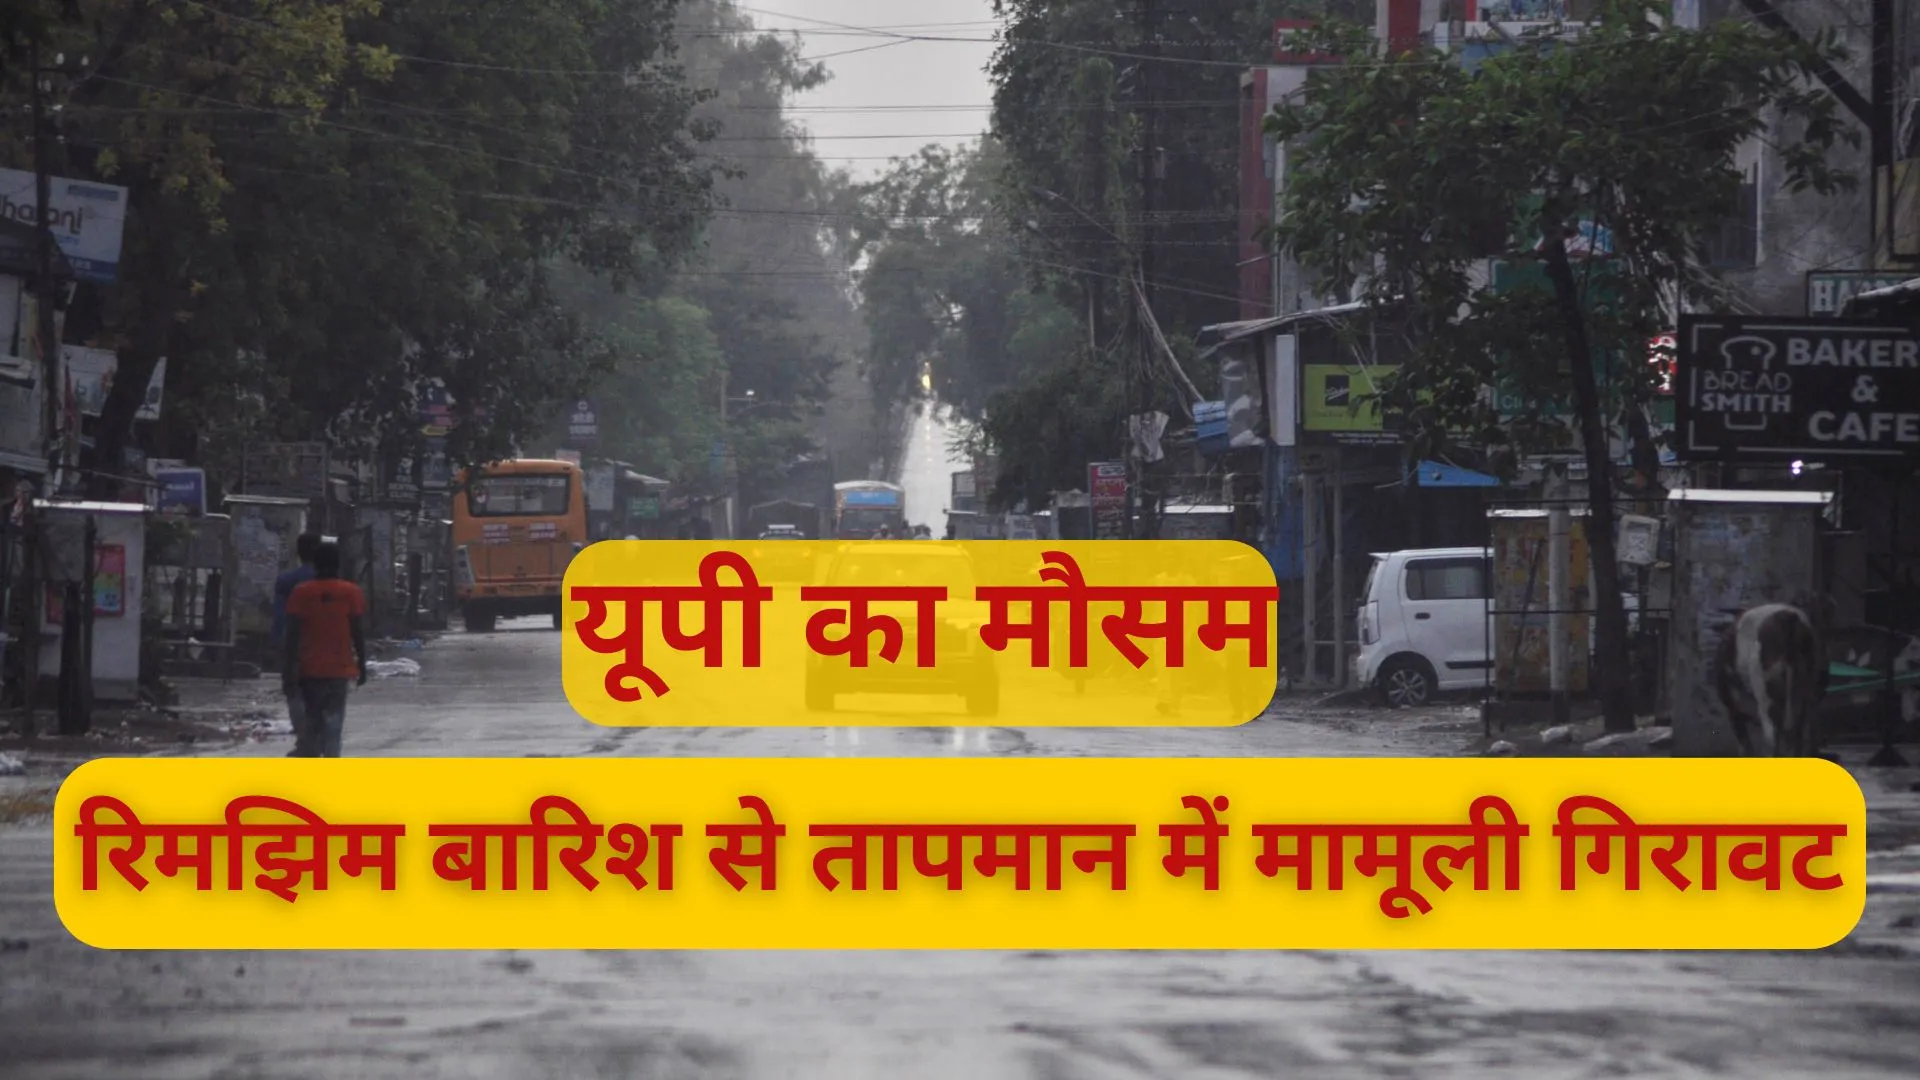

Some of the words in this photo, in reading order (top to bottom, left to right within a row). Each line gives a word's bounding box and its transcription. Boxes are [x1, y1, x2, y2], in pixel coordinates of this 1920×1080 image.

[1786, 338, 1920, 367] BAKER
[1703, 370, 1793, 392] BREAD
[1850, 374, 1879, 403] &
[1701, 392, 1792, 413] SMITH
[1807, 411, 1920, 442] CAFE
